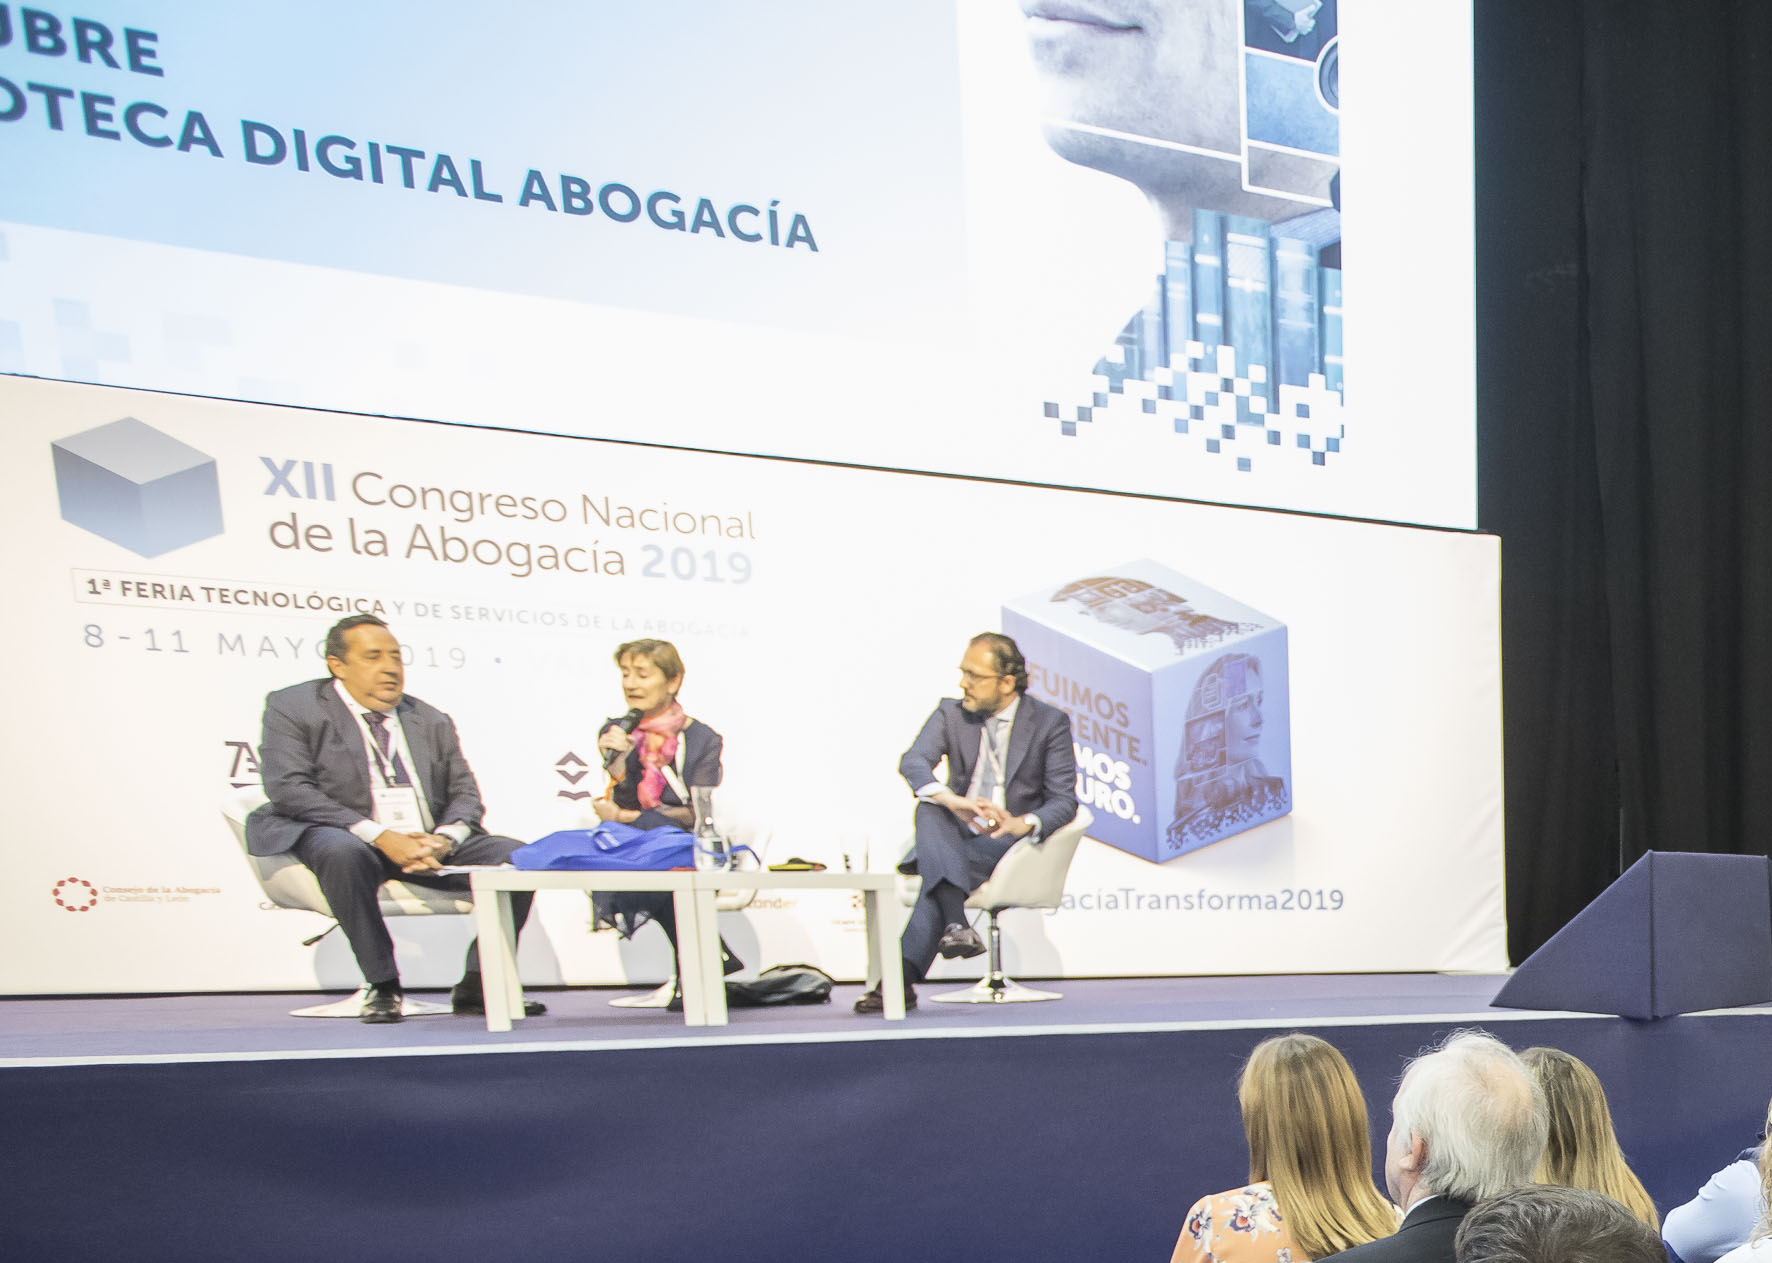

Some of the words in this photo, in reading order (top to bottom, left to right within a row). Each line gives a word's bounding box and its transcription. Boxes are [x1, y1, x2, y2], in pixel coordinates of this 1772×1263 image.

[241, 119, 503, 204] DIGITAL
[518, 169, 820, 253] ABOGACÍA
[259, 456, 336, 501] XII
[351, 471, 567, 522] Congreso
[582, 494, 757, 540] Nacional
[268, 512, 333, 552] de
[349, 518, 389, 557] la
[405, 524, 626, 578] Abogacía
[640, 543, 753, 585] 2019
[120, 580, 196, 602] FERIA
[200, 586, 386, 615] TECNOLÓGICA
[393, 600, 405, 615] Y
[414, 602, 441, 618] DE
[450, 604, 569, 628] SERVICIOS
[84, 623, 104, 649] 8
[398, 643, 466, 669] 019
[1028, 662, 1130, 728] FUIMOS
